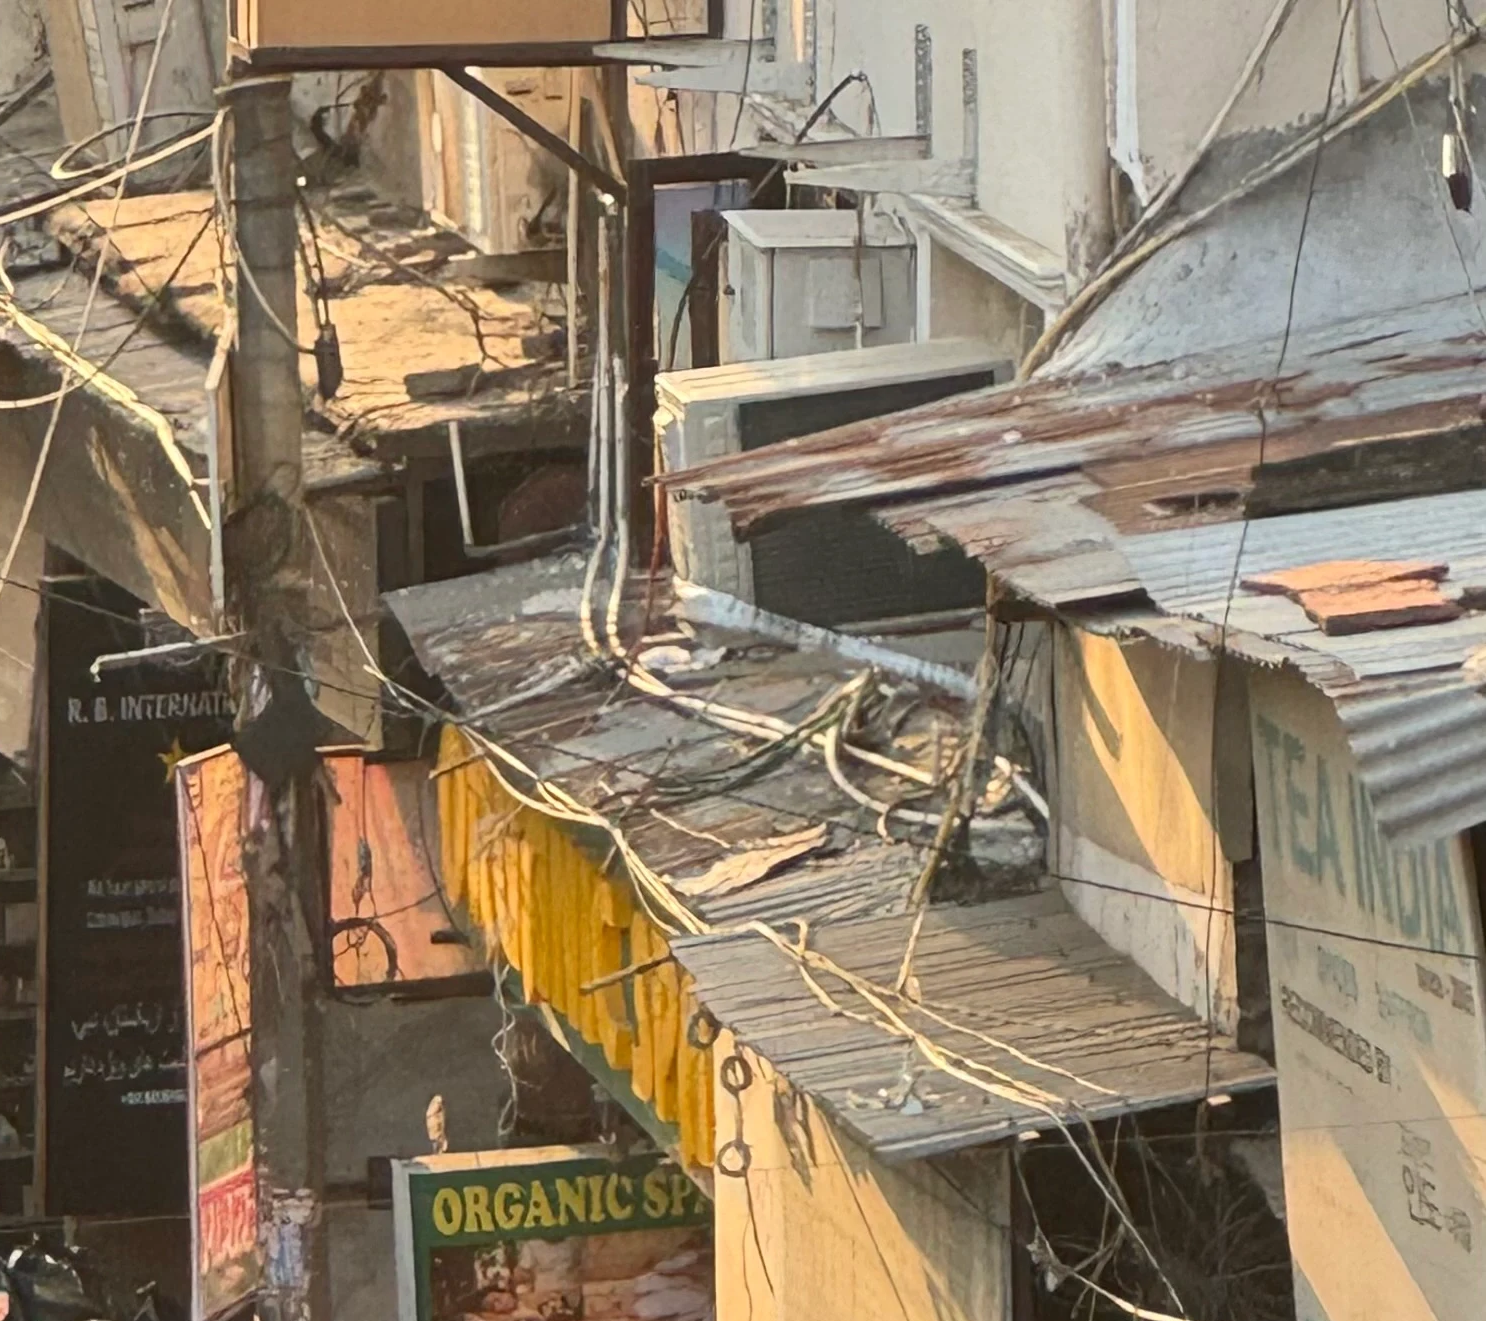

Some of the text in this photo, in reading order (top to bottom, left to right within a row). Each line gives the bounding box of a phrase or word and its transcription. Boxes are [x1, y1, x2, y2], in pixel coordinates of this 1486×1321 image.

[1257, 712, 1469, 954] TEA INDIA
[433, 1168, 705, 1236] ORGANIC SP
